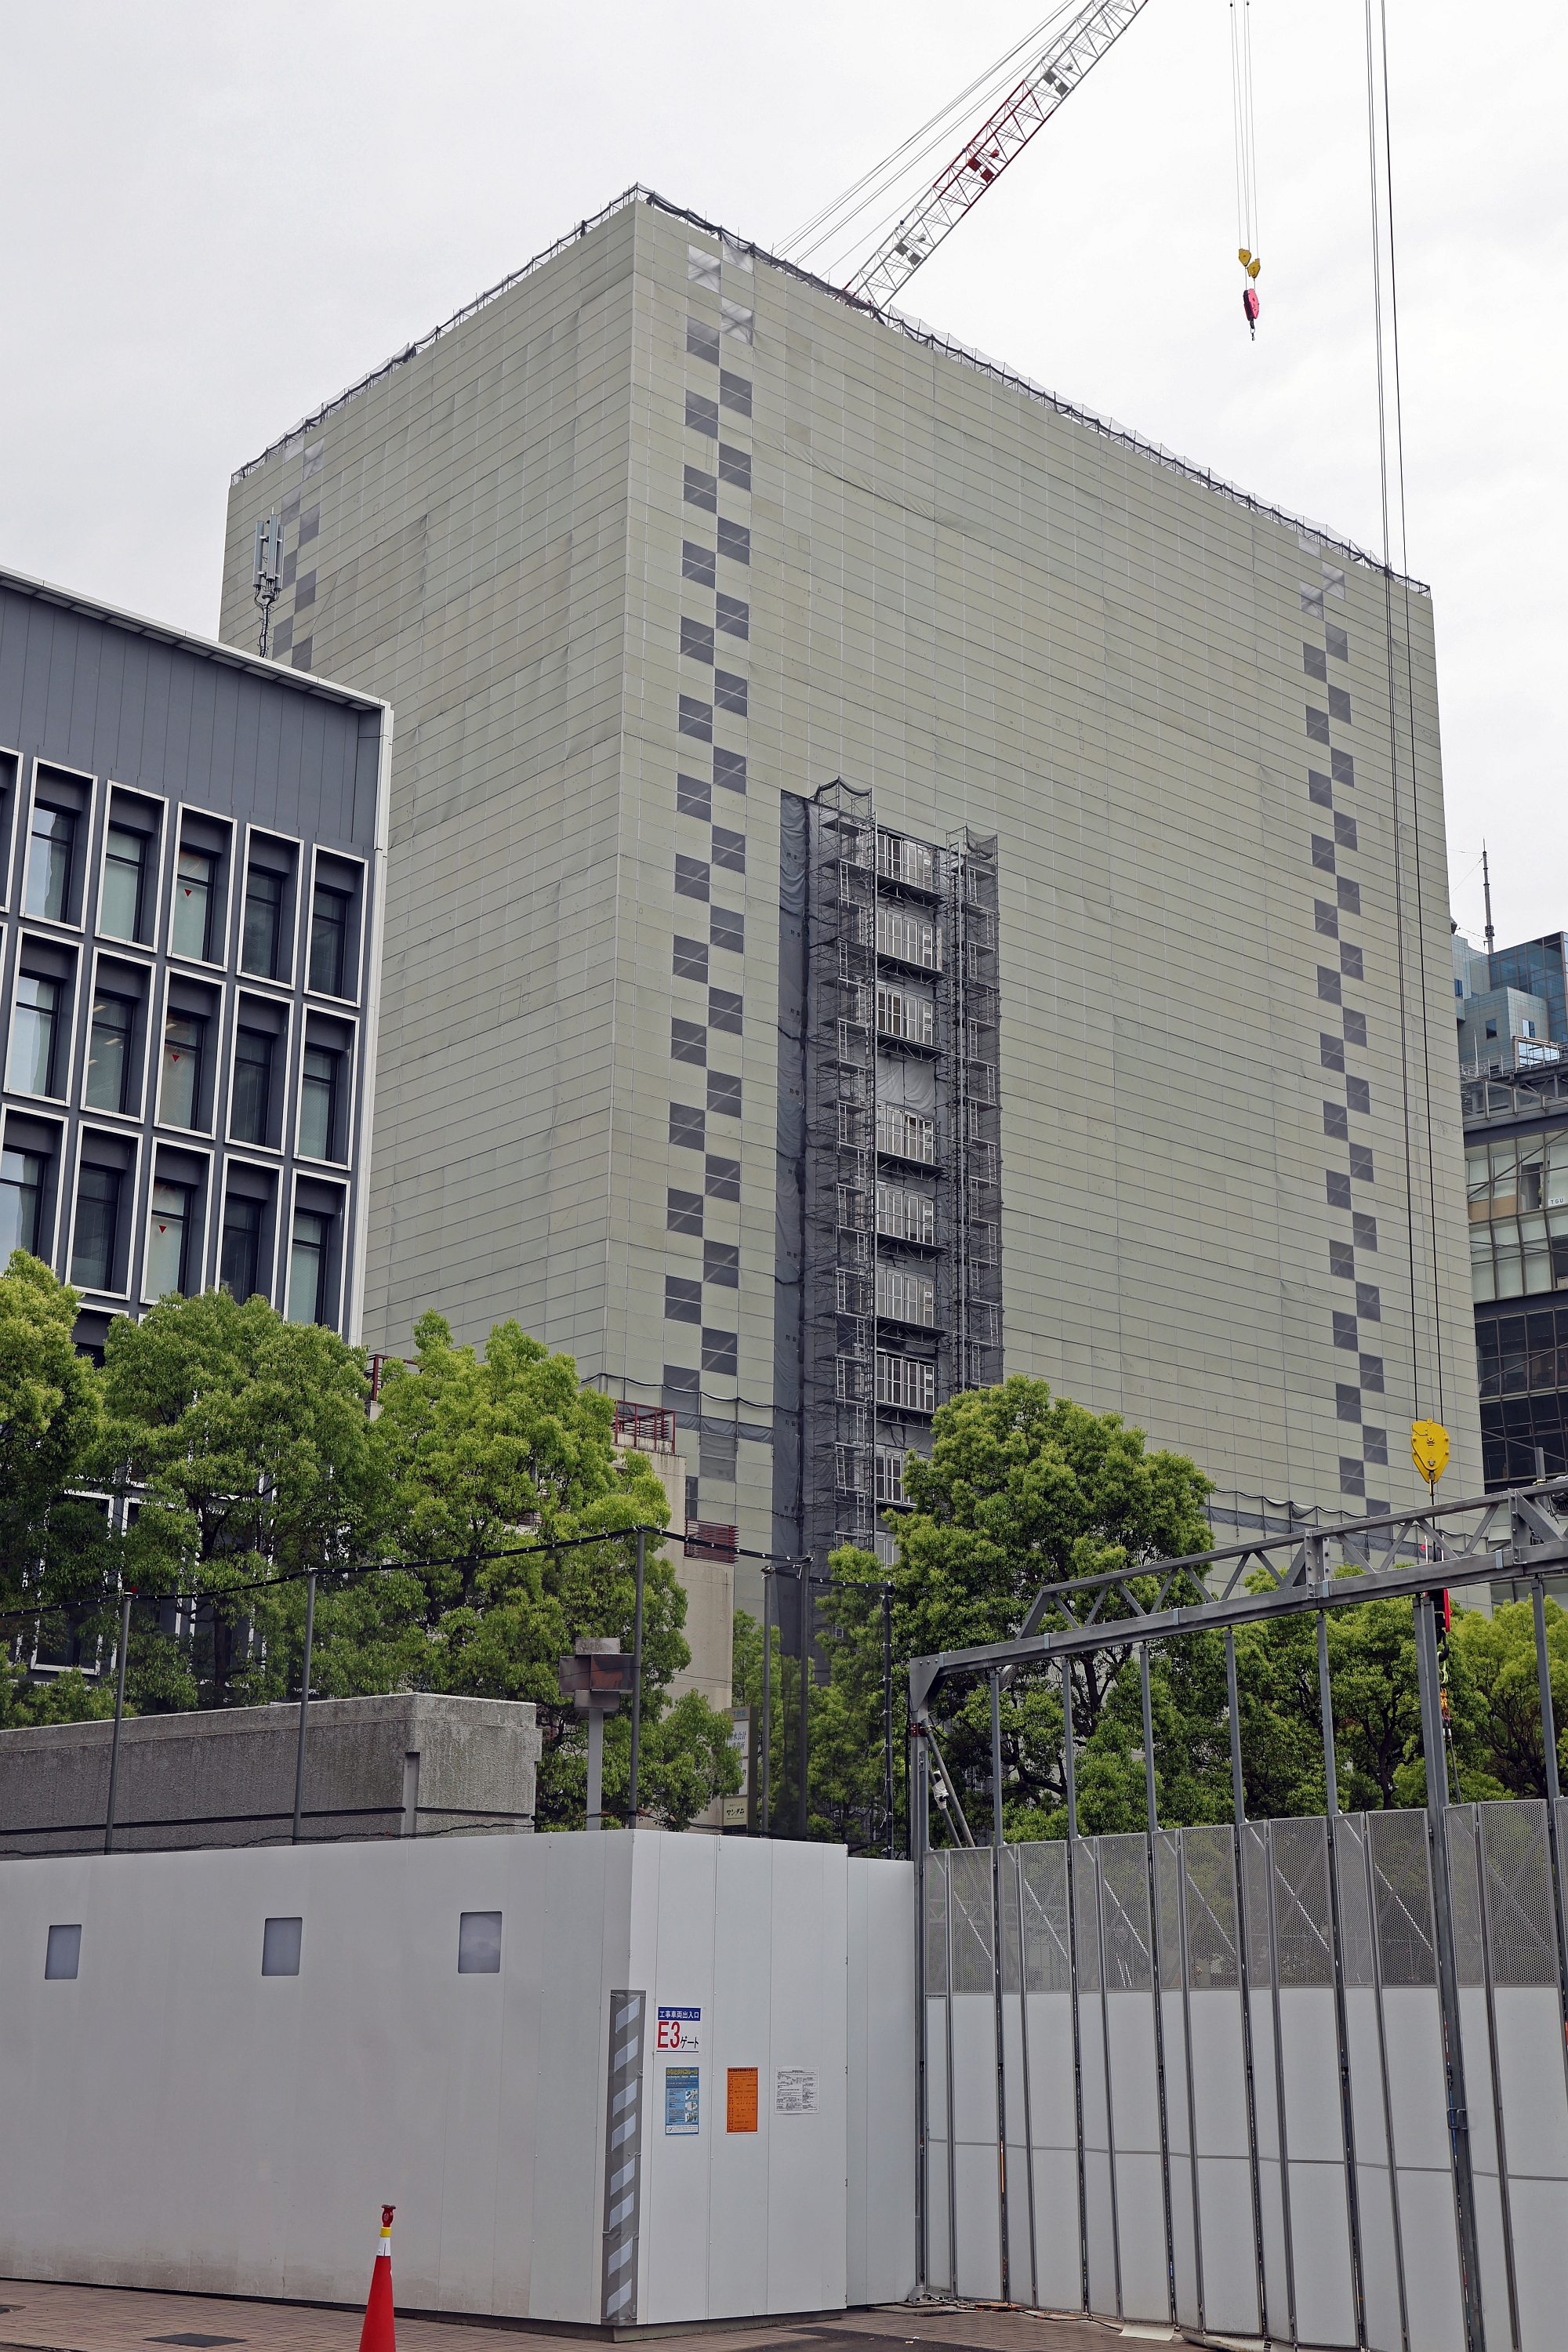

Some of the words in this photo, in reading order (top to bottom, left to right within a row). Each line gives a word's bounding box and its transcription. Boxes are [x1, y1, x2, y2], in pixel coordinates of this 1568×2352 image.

[659, 2010, 699, 2019] 工事車両出入口
